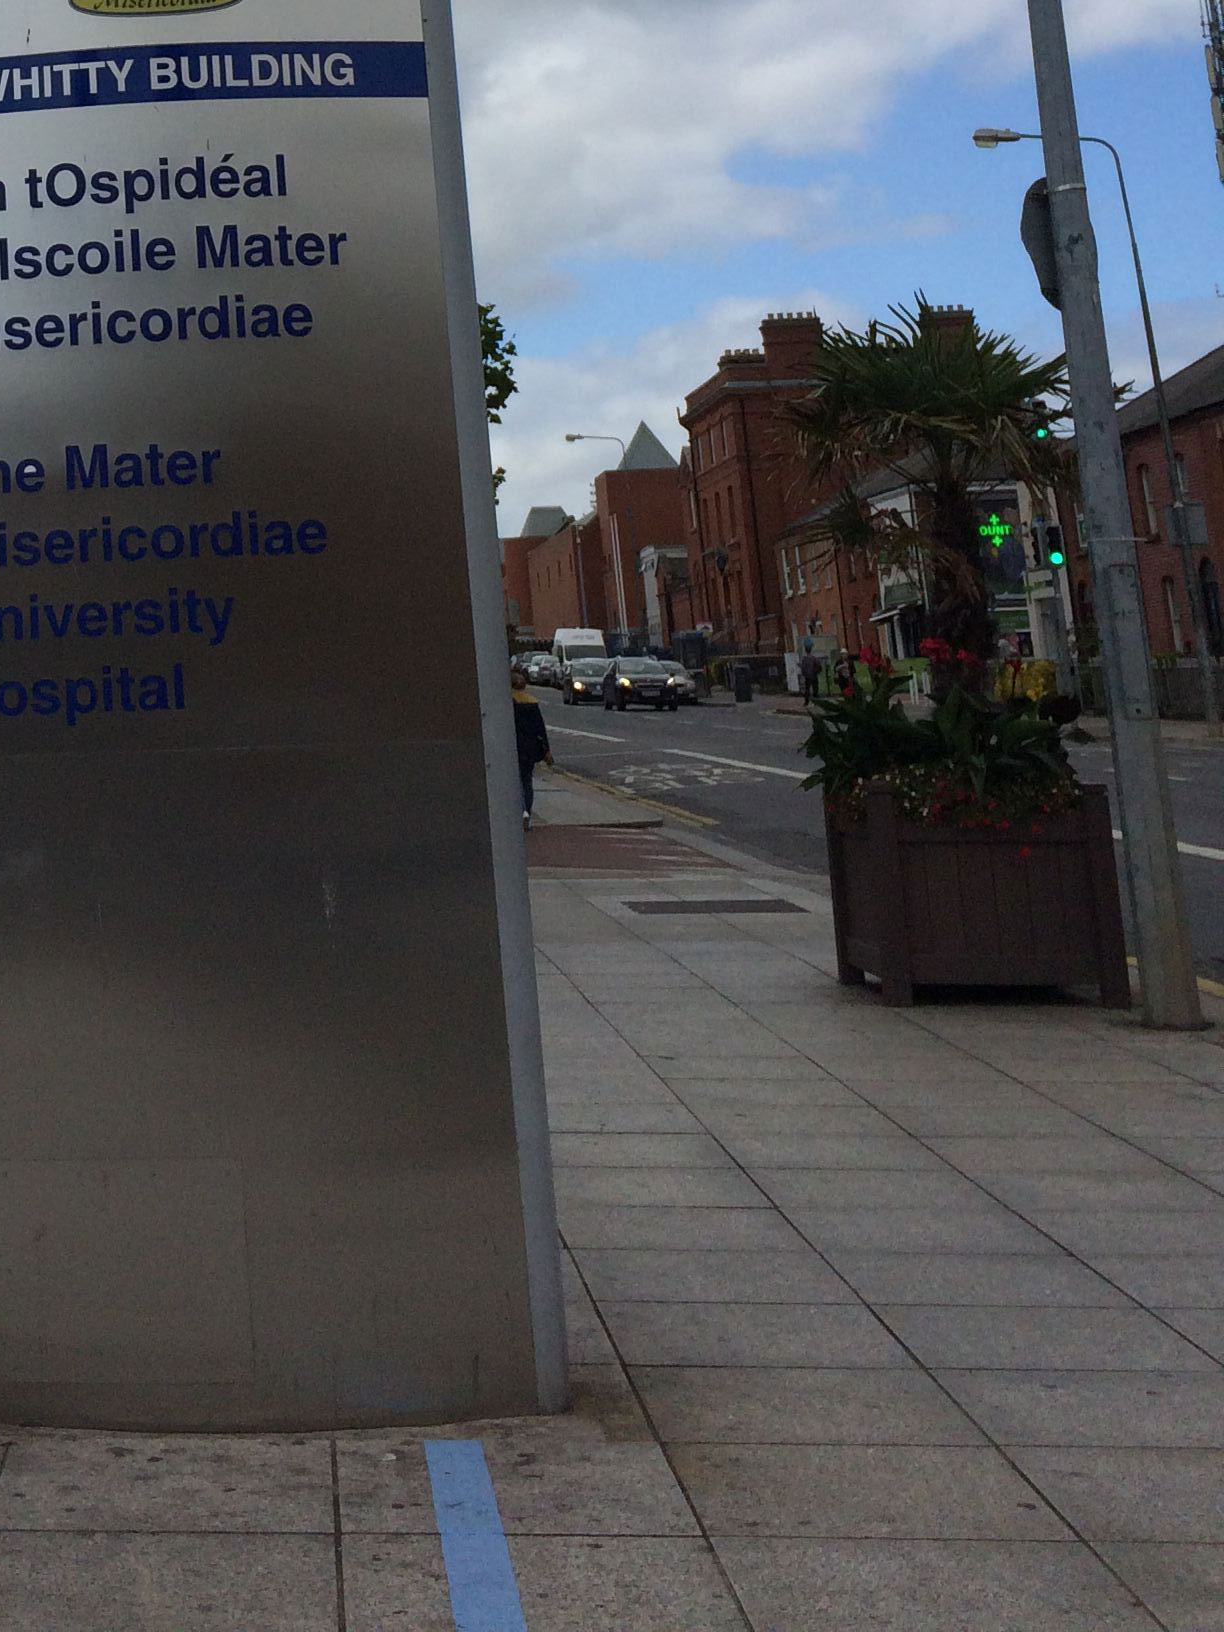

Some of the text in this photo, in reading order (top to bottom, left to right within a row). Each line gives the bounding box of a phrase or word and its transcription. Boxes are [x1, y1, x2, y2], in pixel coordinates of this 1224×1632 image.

[150, 53, 355, 89] BUILDING
[25, 154, 288, 212] tOspidéal
[196, 225, 348, 269] Mater
[65, 443, 221, 491] Mater
